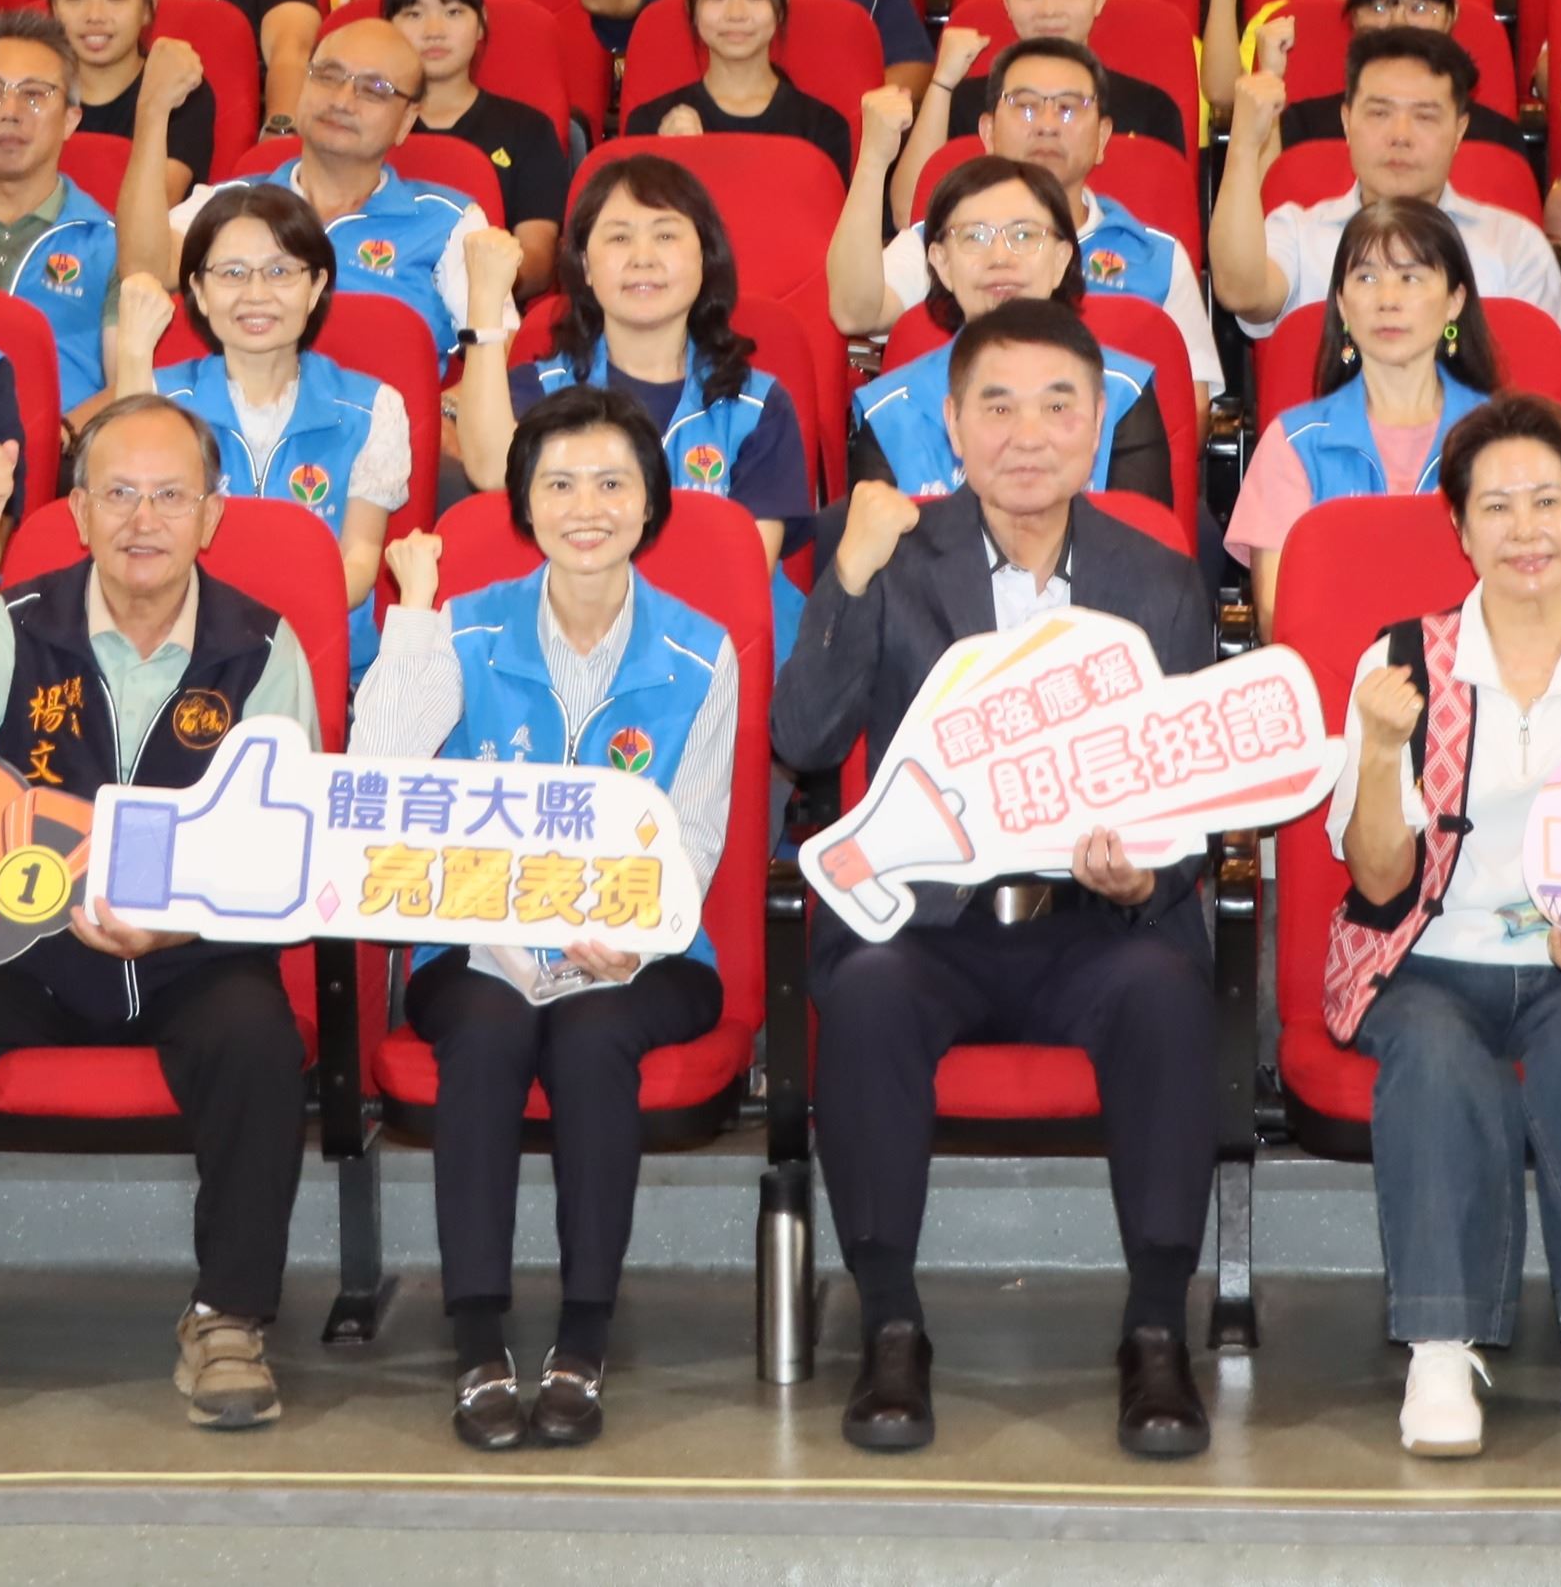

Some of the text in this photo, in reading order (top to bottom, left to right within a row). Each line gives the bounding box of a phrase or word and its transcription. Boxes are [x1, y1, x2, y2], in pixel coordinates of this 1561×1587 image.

[934, 642, 1144, 768] 最強應援
[988, 674, 1306, 833] 縣長挺讚
[327, 770, 597, 841] 體育大縣
[358, 843, 664, 928] 亮麗表現
